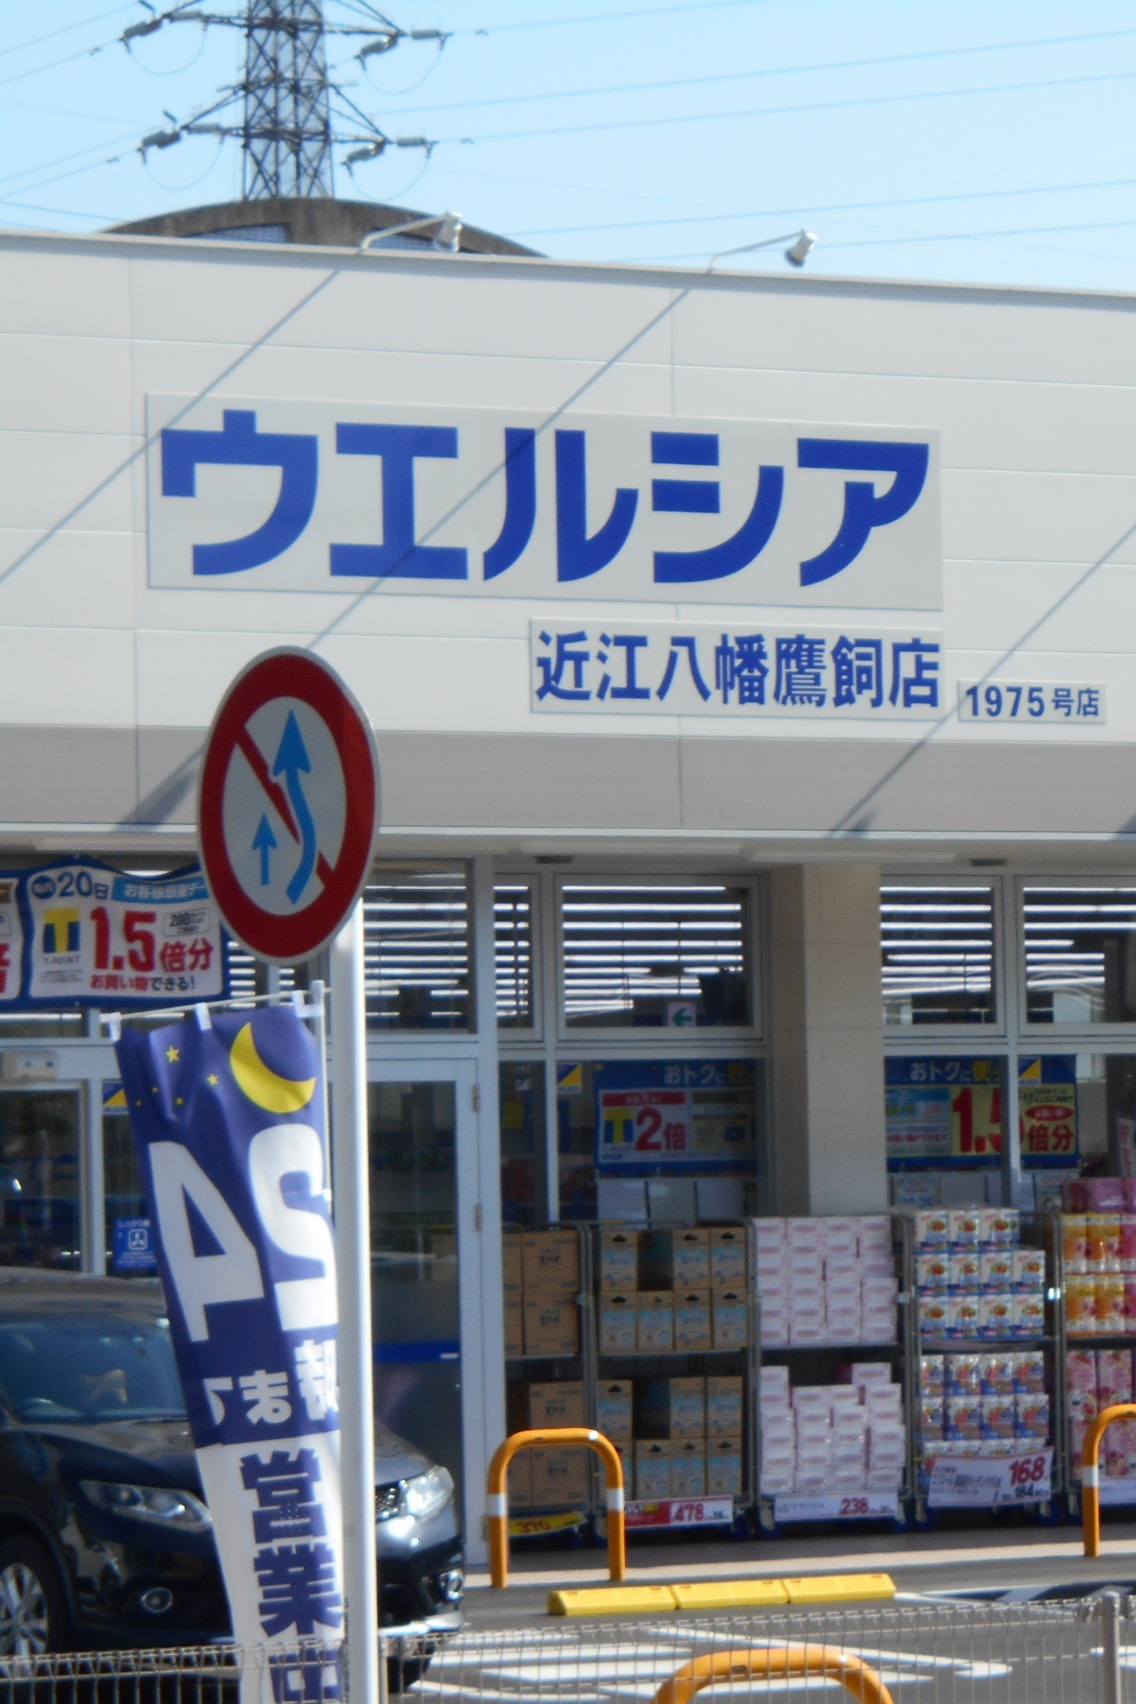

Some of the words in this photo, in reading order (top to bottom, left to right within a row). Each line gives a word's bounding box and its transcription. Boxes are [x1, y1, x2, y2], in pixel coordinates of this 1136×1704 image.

[161, 410, 932, 588] ウエルシア
[537, 630, 941, 710] 近江八幡鷹飼店
[966, 685, 1101, 719] 1975号店
